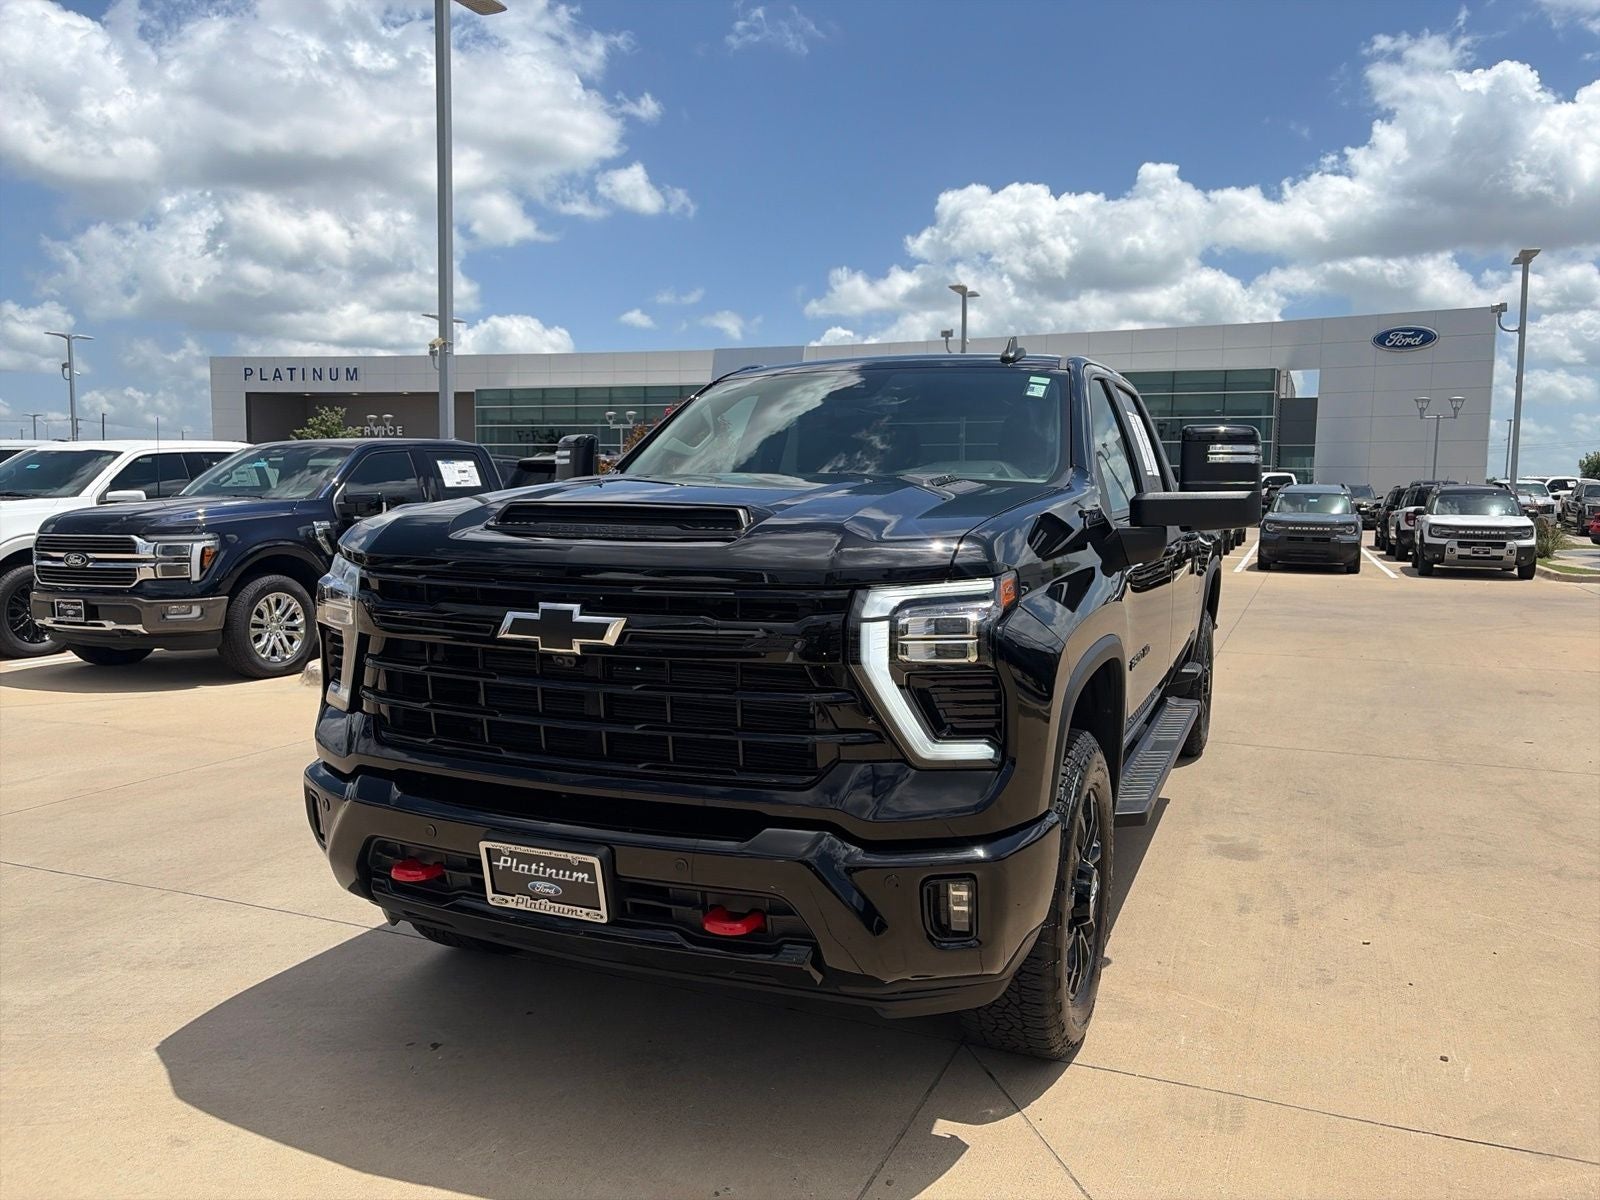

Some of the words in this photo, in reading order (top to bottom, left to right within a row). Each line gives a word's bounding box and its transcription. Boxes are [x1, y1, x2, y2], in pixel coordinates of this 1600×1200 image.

[1385, 331, 1424, 347] Ford
[243, 367, 359, 382] PLATINUM
[492, 856, 596, 884] Platinum
[534, 883, 556, 894] Ford
[515, 896, 583, 917] Platinum
